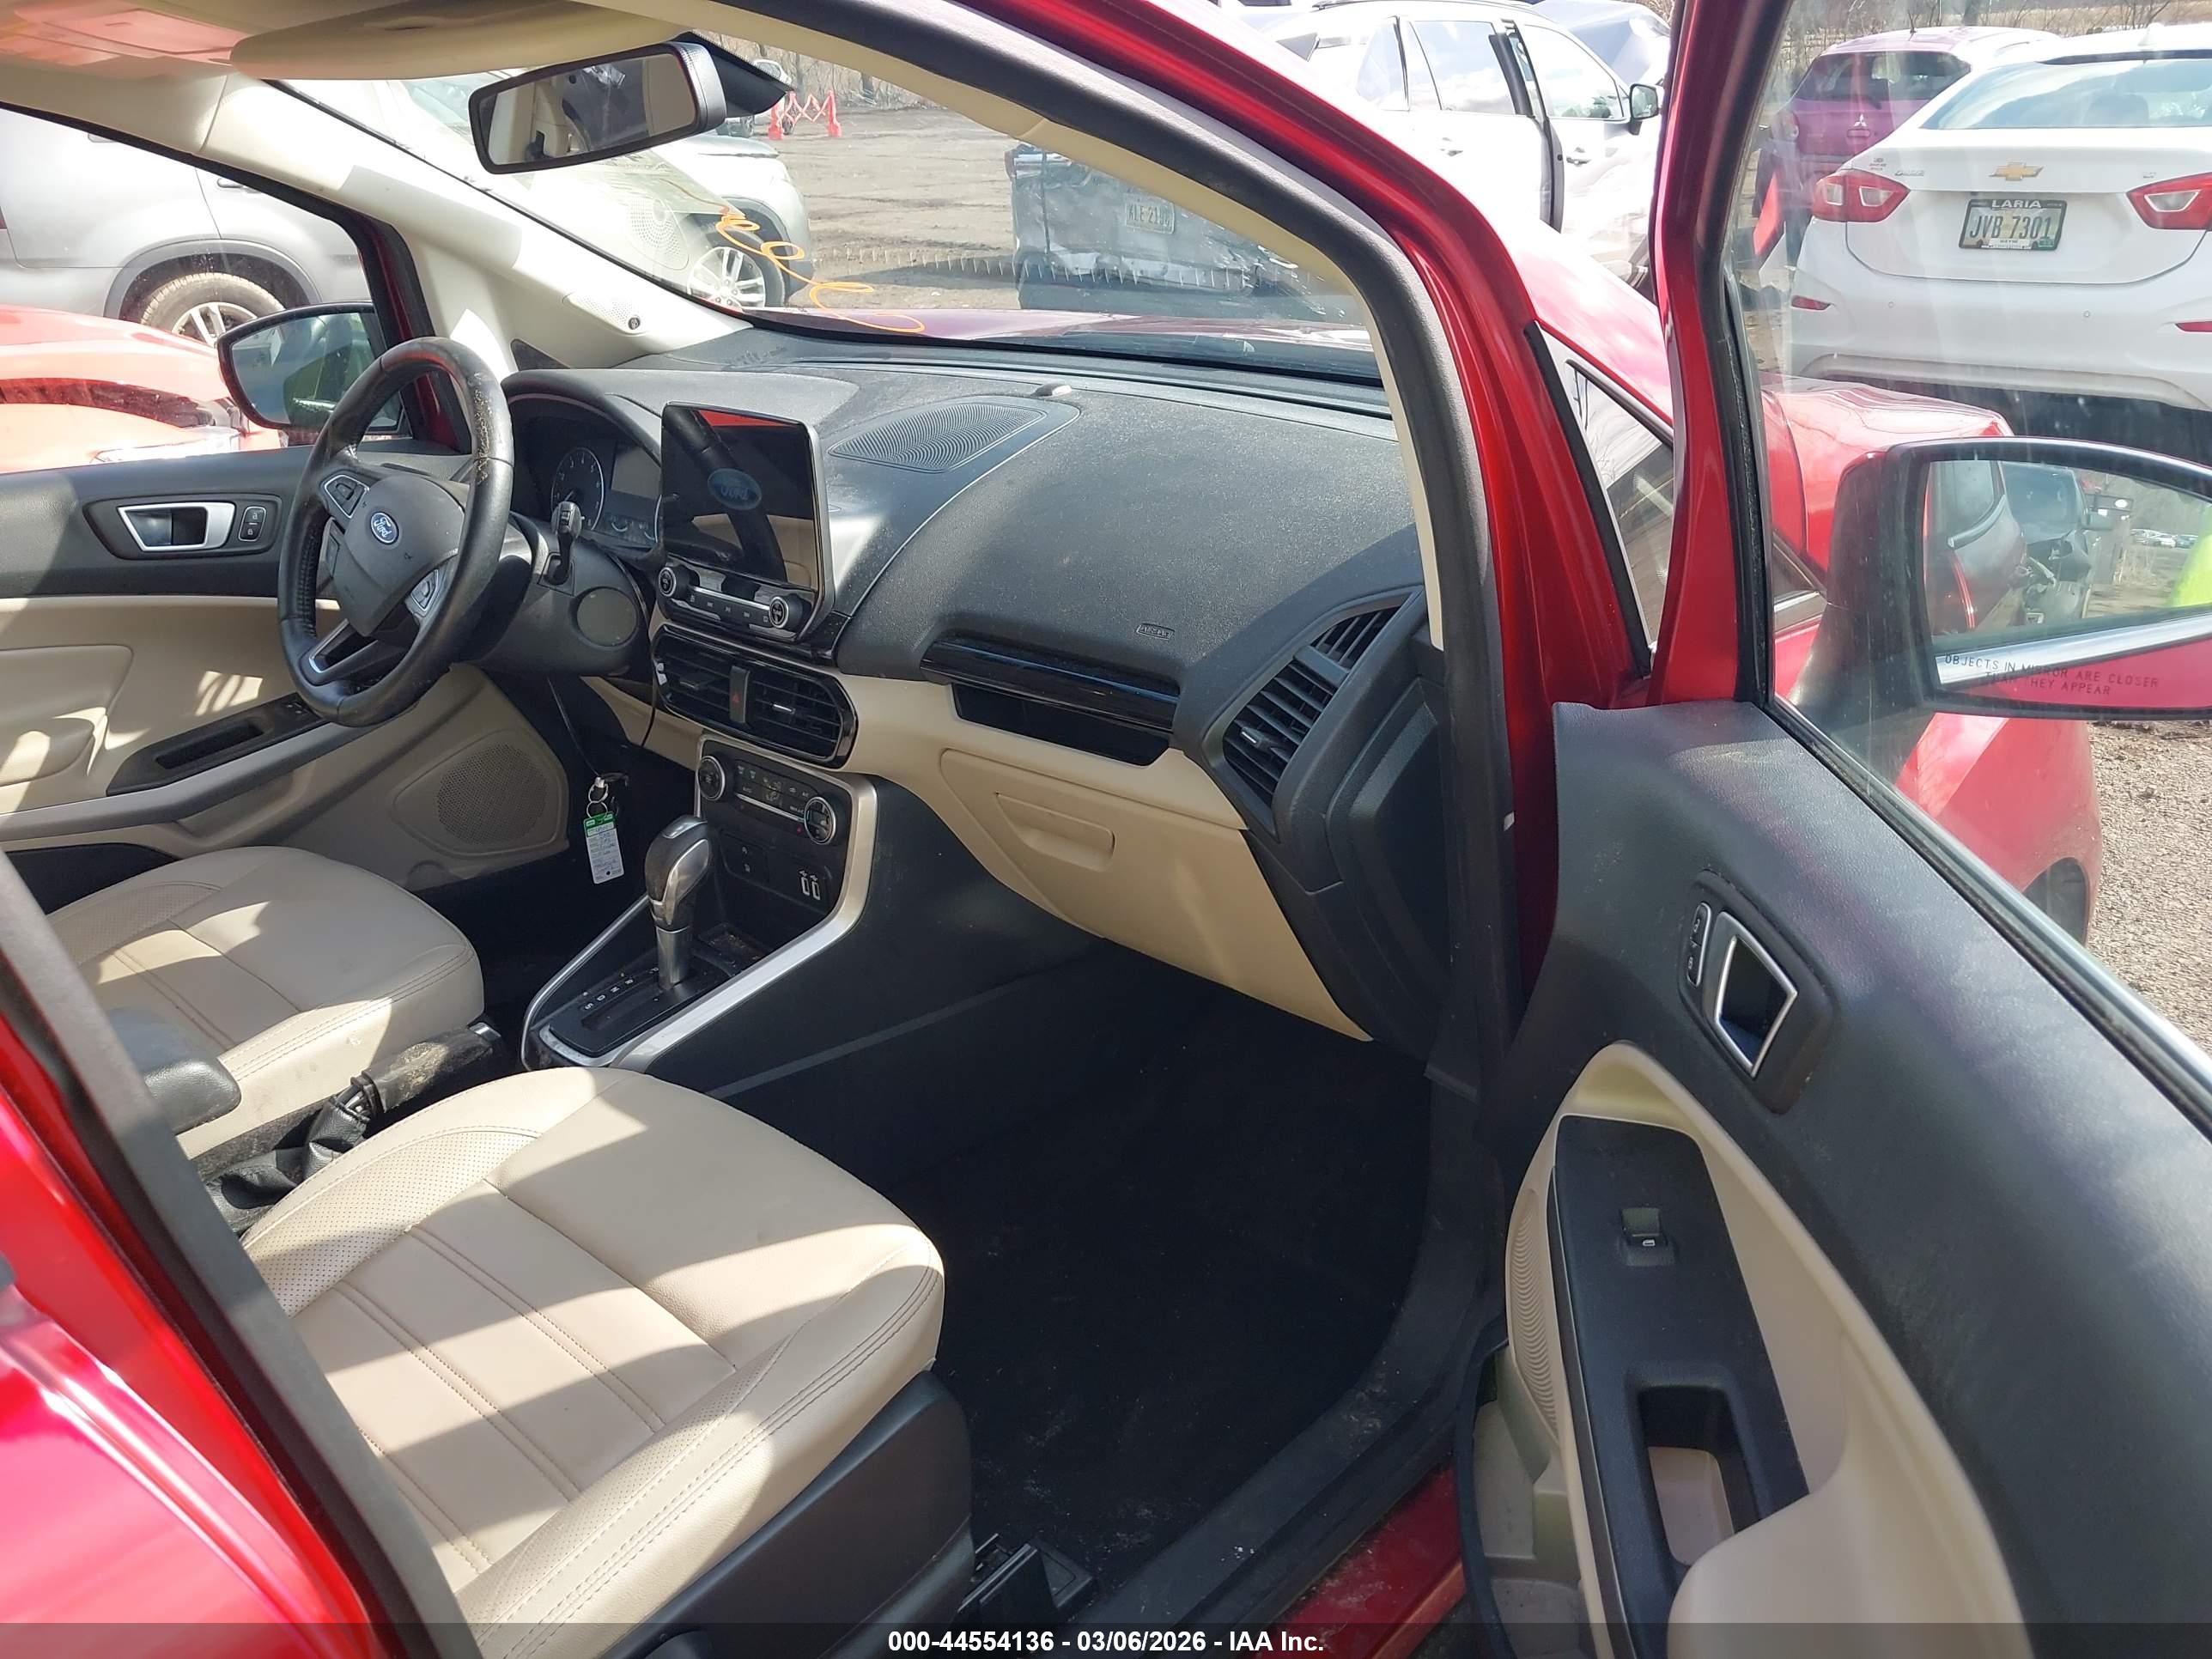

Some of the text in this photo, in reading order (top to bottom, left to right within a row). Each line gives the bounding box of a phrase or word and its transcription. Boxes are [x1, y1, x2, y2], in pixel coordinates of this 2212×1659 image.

[1991, 199, 2042, 208] LARIA
[1969, 216, 2052, 239] JVB 7301
[374, 516, 392, 538] Ford
[1945, 654, 1999, 670] OBJECTS
[2003, 661, 2016, 672] IN
[2075, 670, 2101, 683] ARE
[2108, 672, 2159, 688] CLOSER
[2061, 683, 2111, 696] APPEAR
